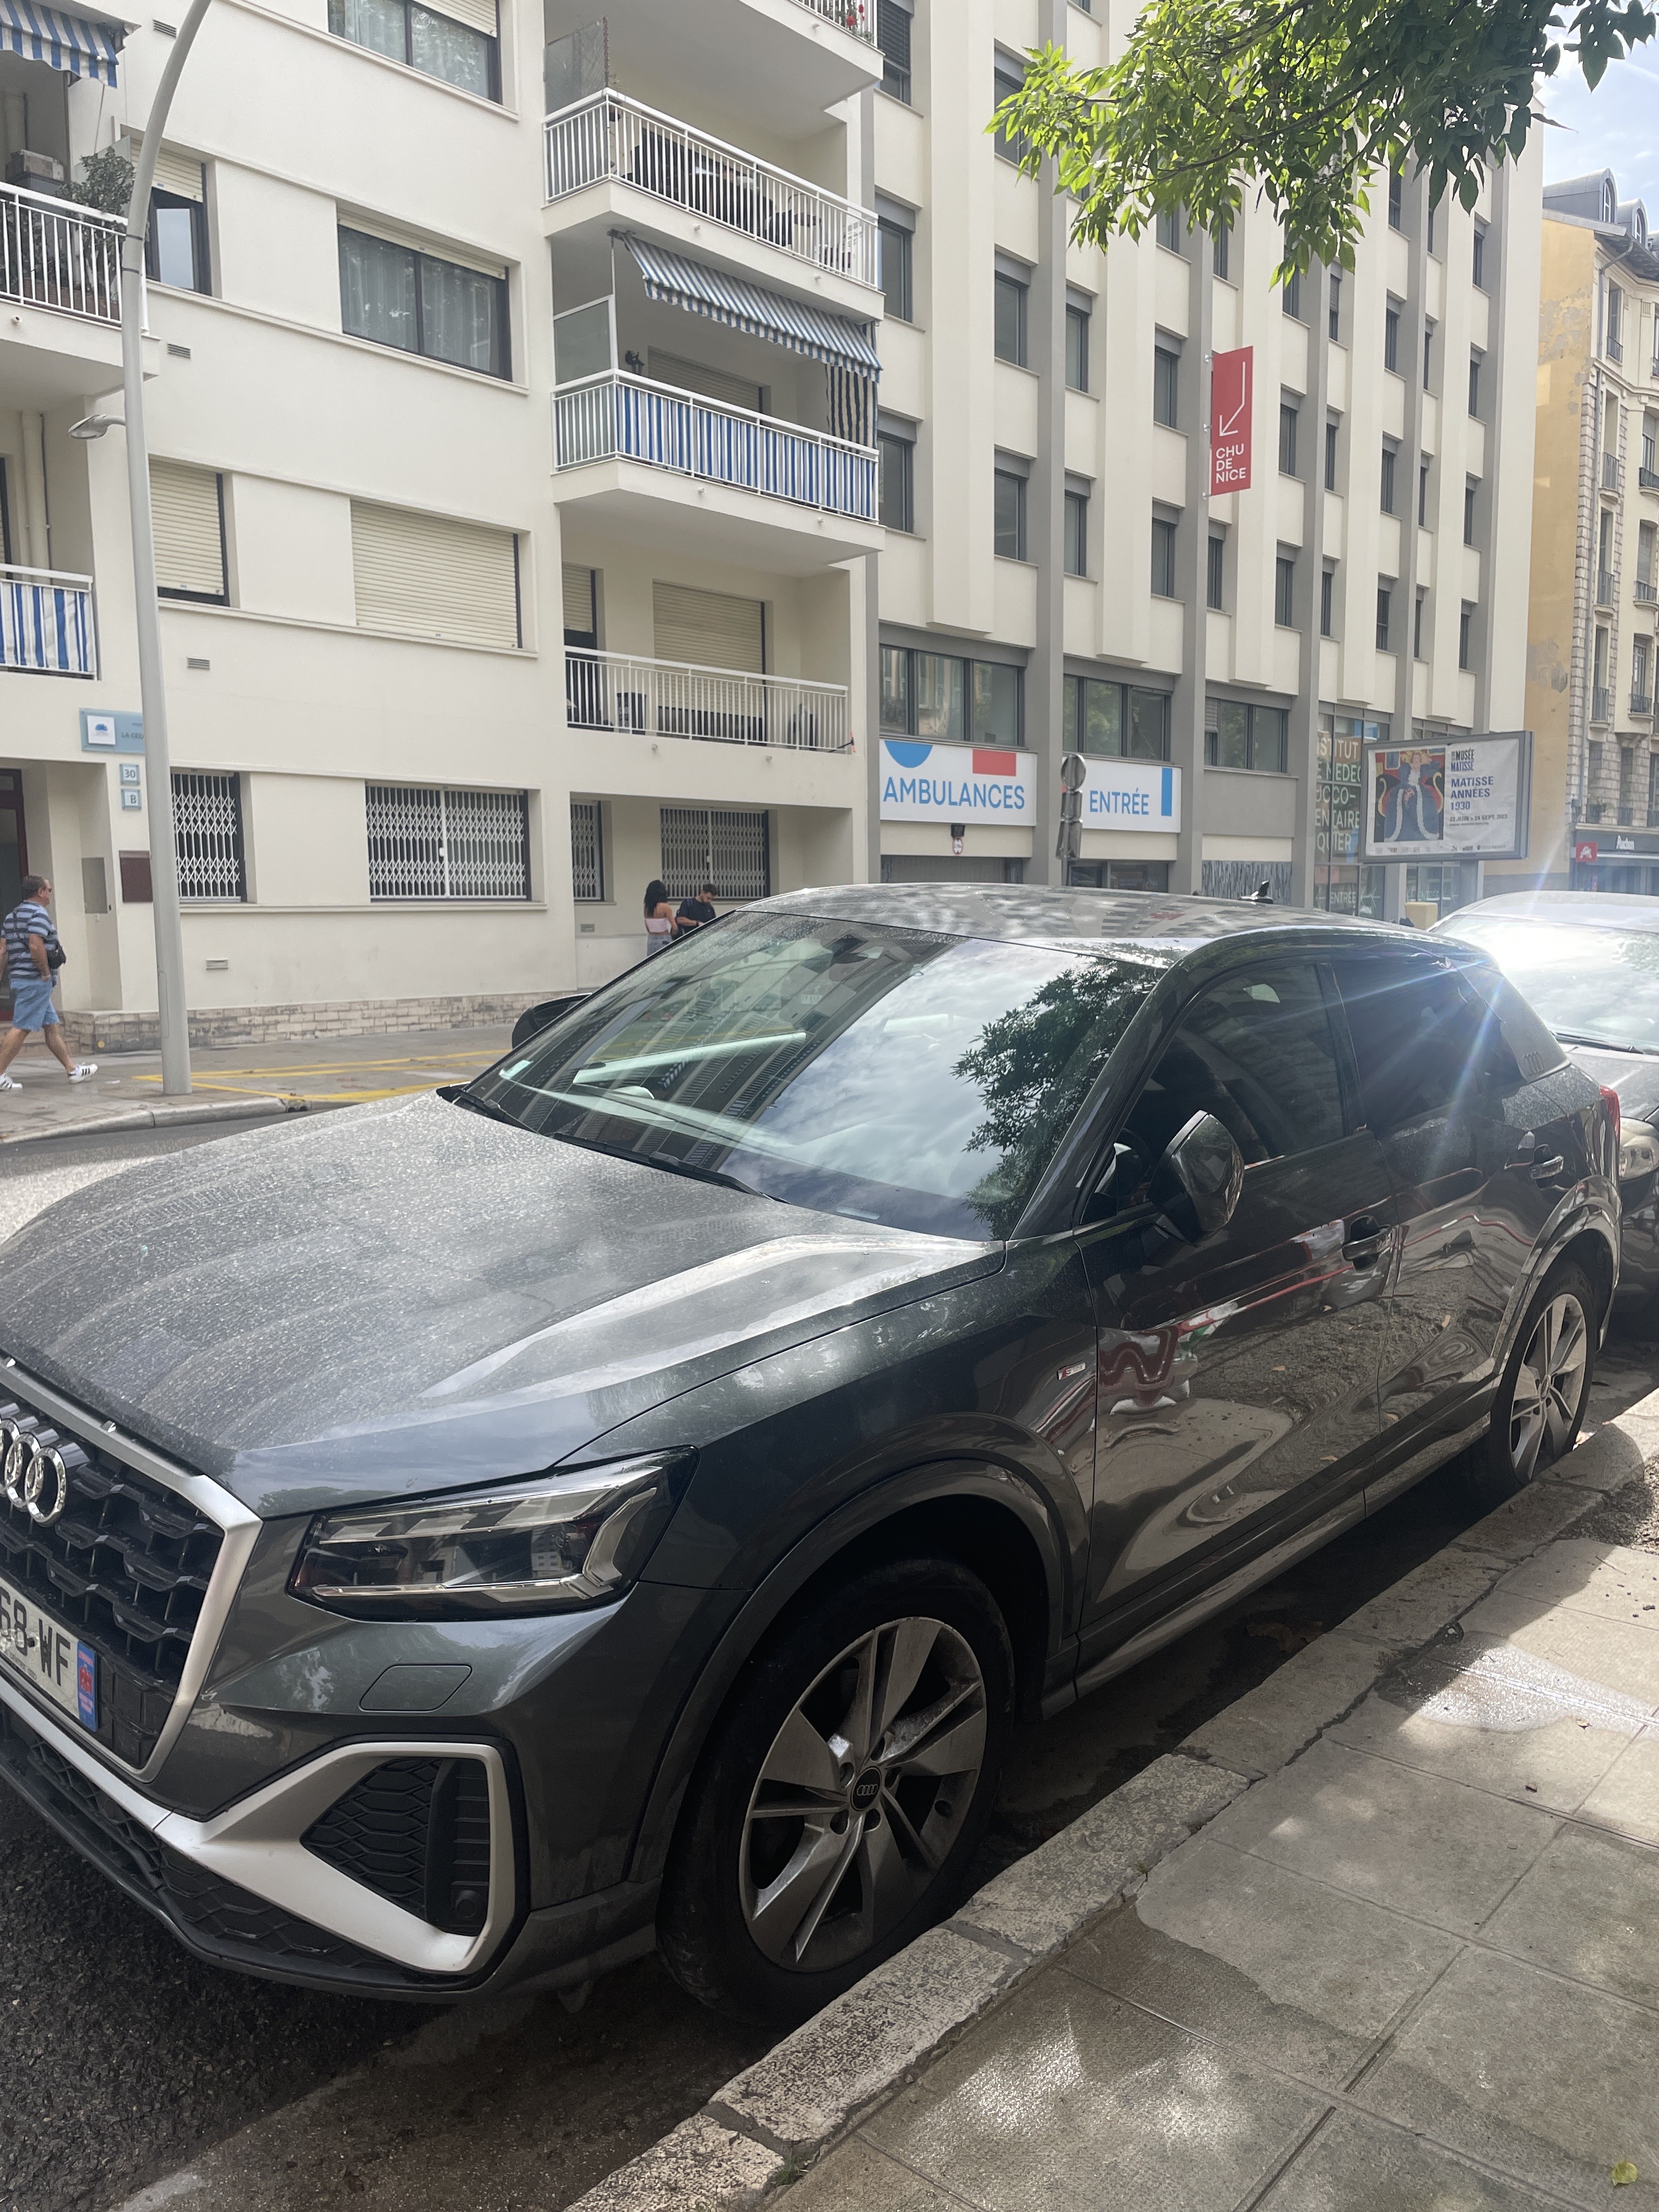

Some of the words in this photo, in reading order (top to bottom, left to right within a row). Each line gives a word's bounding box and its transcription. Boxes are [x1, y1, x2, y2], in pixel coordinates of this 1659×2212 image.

[1216, 443, 1244, 459] CHU
[1216, 458, 1233, 471] DE
[1216, 467, 1246, 483] NICE
[125, 769, 136, 778] 30
[1451, 776, 1494, 788] MATISSE
[131, 794, 136, 804] B
[883, 776, 1025, 810] AMBULANCES
[1451, 787, 1490, 799] ANNÉES
[1090, 787, 1149, 815] ENTRÉE
[1451, 802, 1470, 810] 1930
